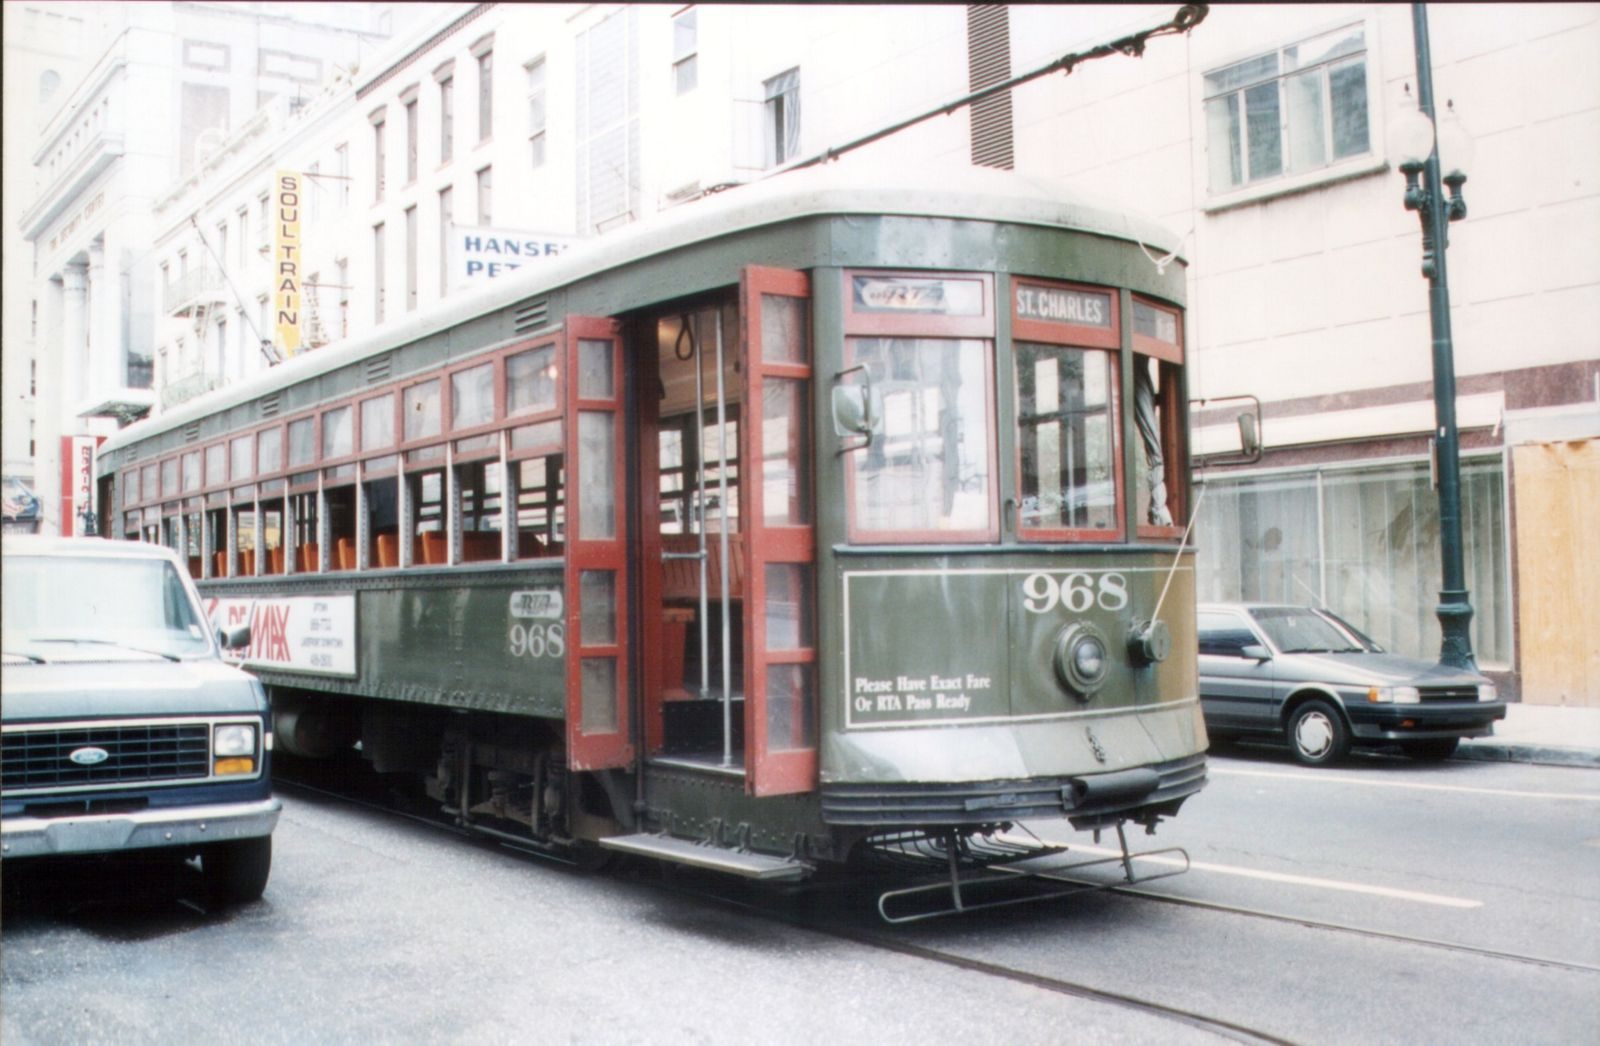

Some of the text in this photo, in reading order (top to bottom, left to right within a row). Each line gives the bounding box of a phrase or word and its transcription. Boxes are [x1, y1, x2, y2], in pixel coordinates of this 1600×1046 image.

[278, 176, 298, 326] SOUL TRAIN
[1016, 289, 1102, 324] ST. CHARLES
[1023, 572, 1128, 614] 968
[510, 624, 565, 658] 968
[855, 673, 991, 693] Please Have Exact Fare
[855, 693, 972, 712] Or RTA Pass Ready
